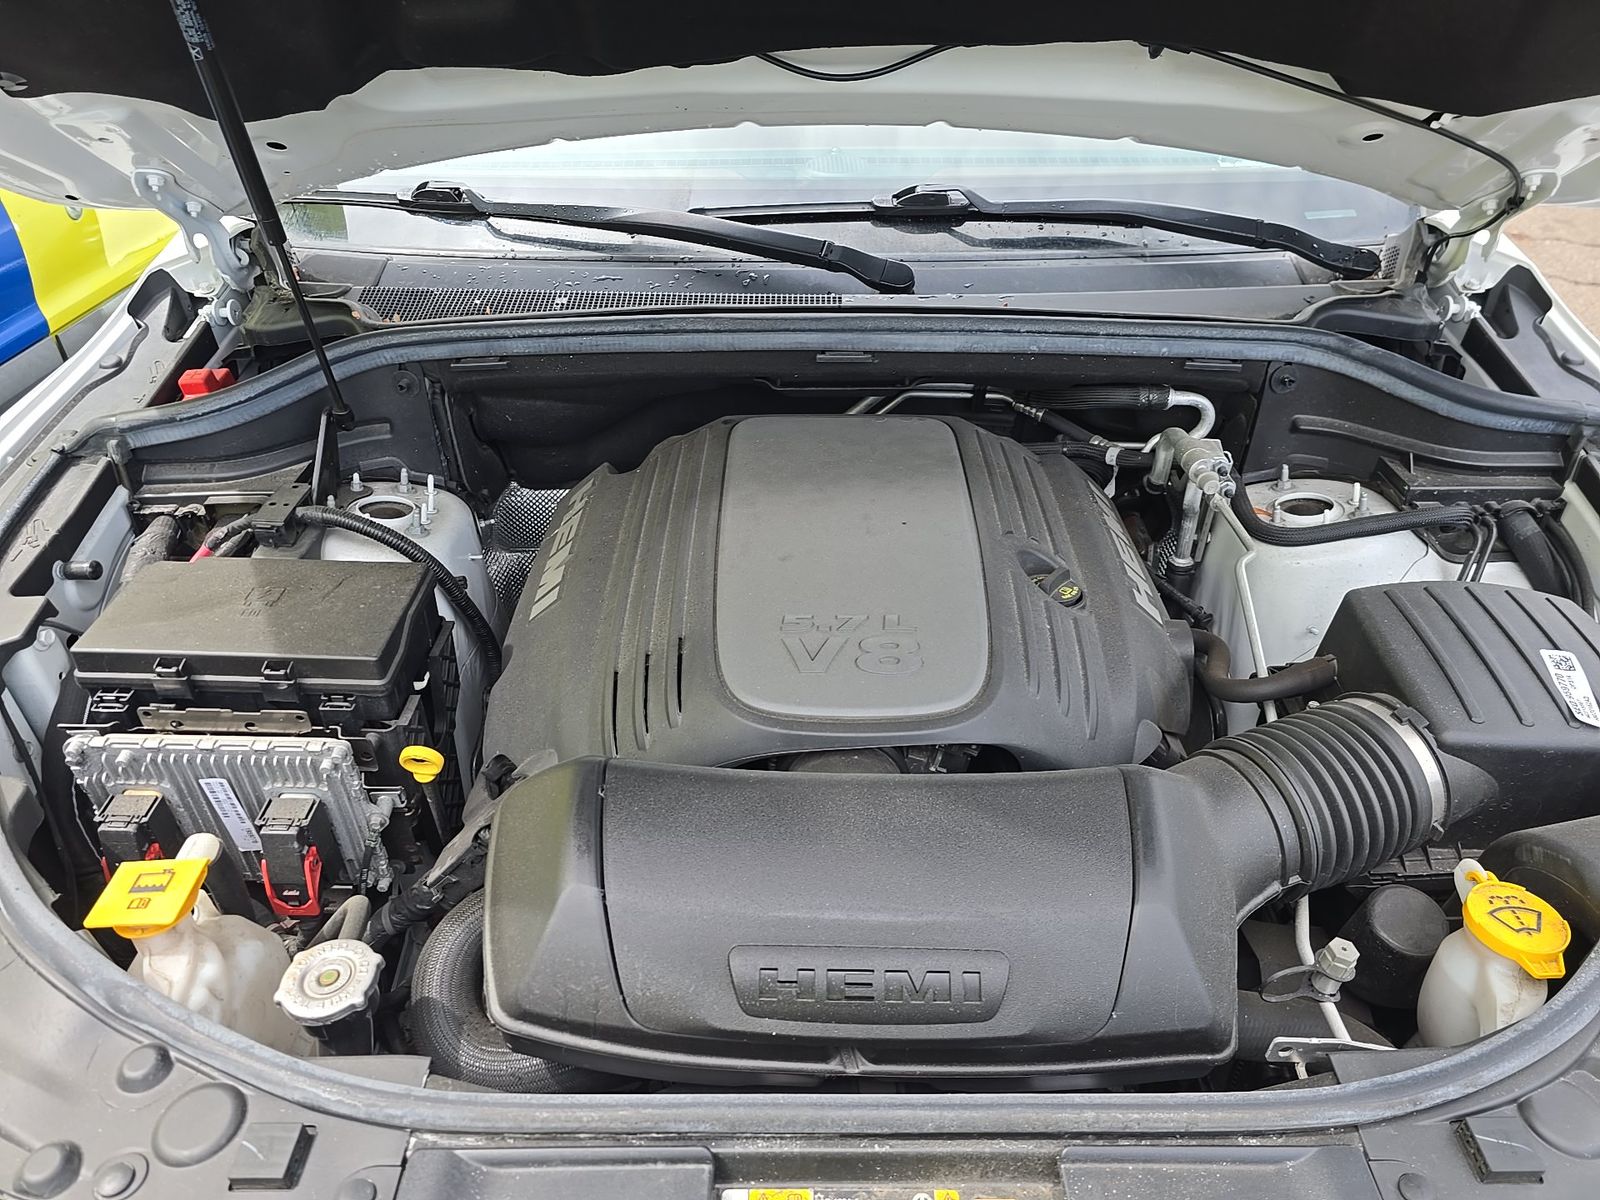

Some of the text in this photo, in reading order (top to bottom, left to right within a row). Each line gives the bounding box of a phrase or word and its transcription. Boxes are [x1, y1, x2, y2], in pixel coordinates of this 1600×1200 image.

[528, 477, 595, 623] HEMI
[1087, 479, 1164, 625] HEMI
[780, 635, 925, 675] V8
[758, 967, 982, 1004] HEMI
